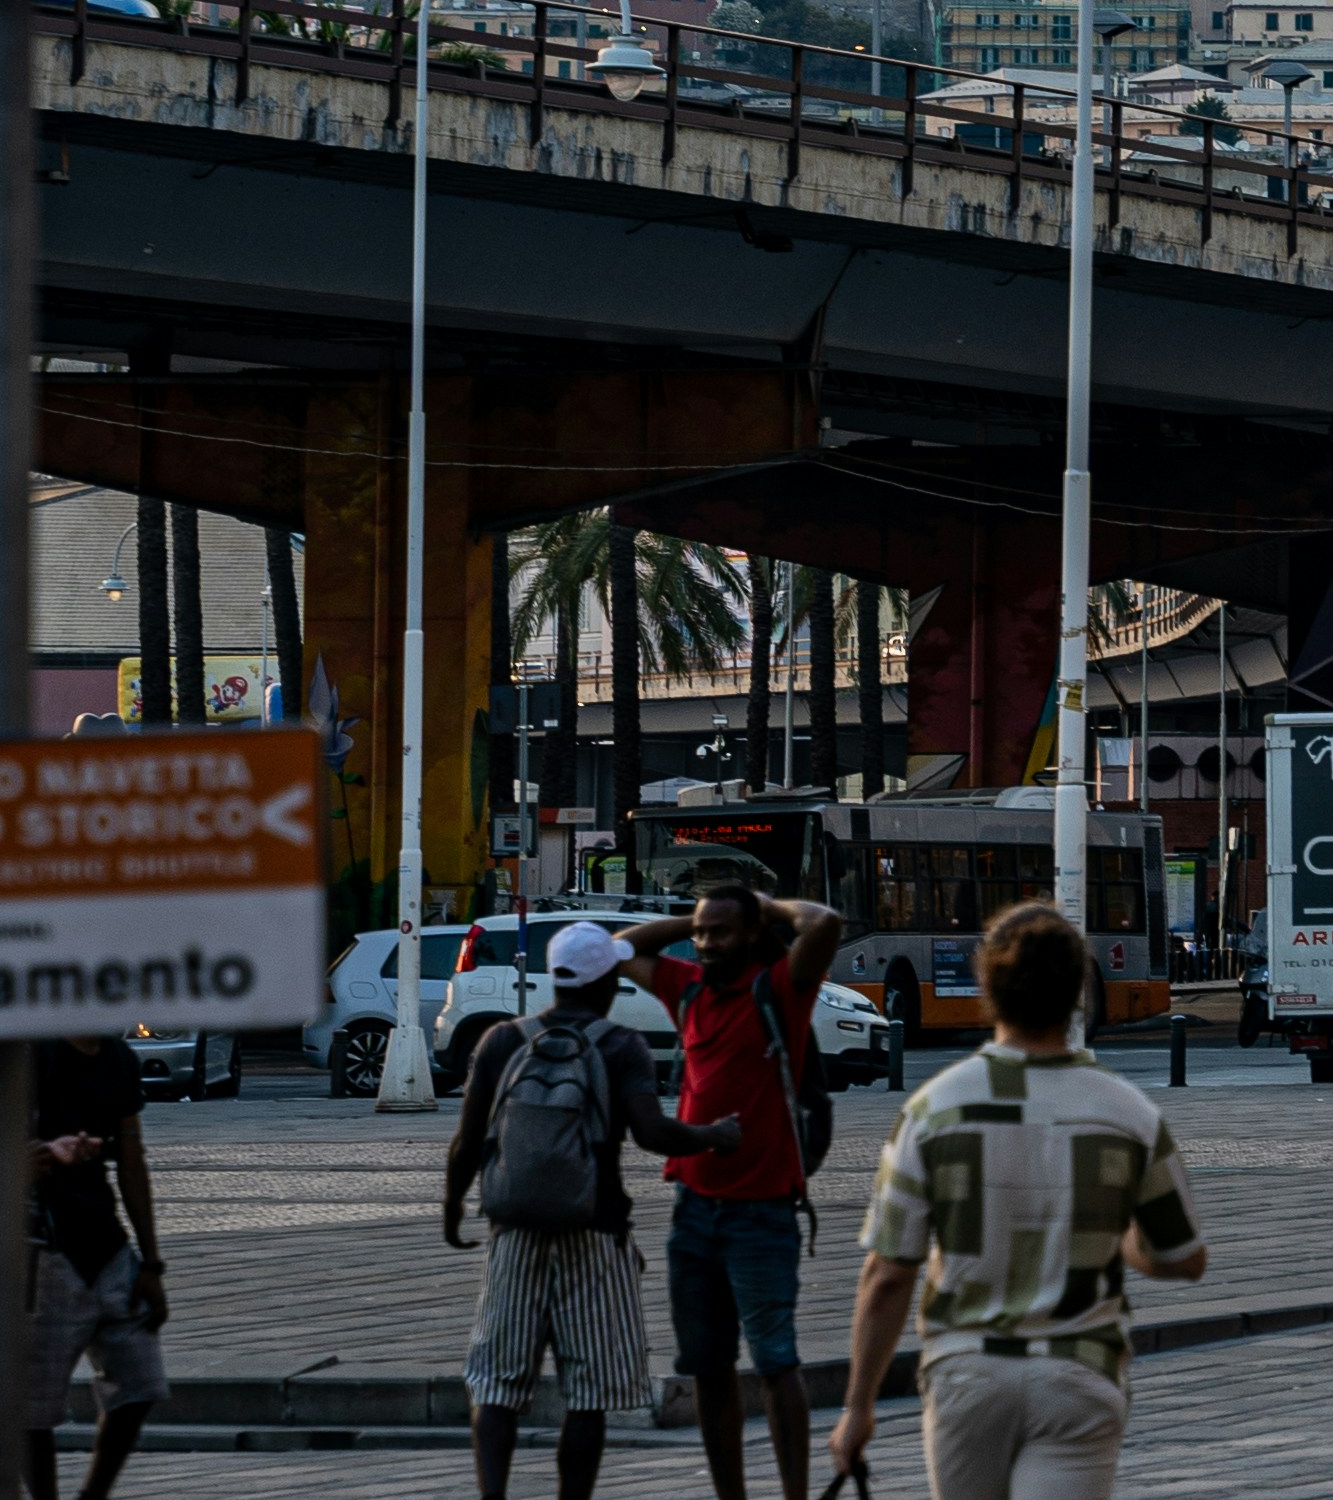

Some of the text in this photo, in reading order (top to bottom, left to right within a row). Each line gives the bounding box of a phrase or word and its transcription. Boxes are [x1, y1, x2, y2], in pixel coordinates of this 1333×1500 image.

[38, 753, 250, 796] NAVETTA
[17, 796, 253, 847] STORICO
[1283, 960, 1307, 968] TEL.
